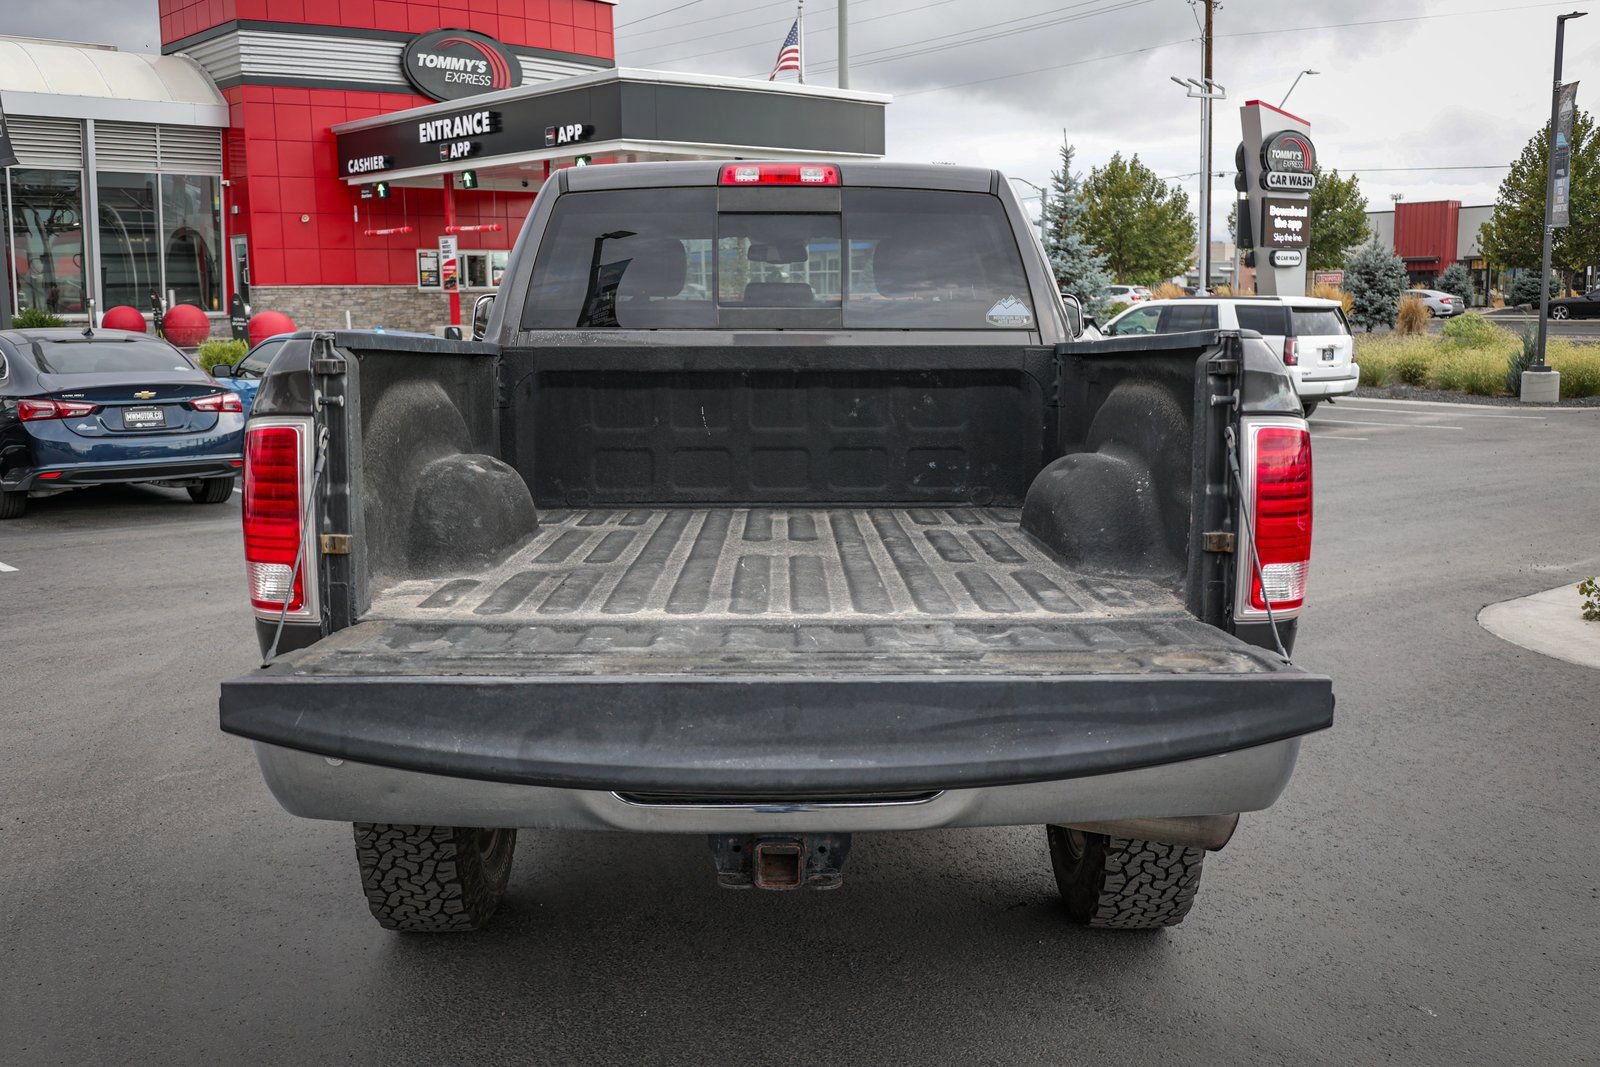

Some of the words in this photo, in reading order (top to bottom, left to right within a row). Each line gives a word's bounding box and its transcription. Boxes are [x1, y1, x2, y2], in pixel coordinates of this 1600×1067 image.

[417, 53, 487, 74] TOMMY'S
[445, 71, 492, 87] EXPRESS
[418, 111, 491, 143] ENTRANCE
[557, 123, 583, 144] APP
[450, 140, 471, 159] APP
[1271, 149, 1303, 161] TOMMY'S
[347, 155, 385, 173] CASHIER
[1282, 160, 1304, 169] EXPRESS
[1270, 174, 1287, 186] CAR
[1289, 175, 1313, 187] WASH
[1269, 205, 1308, 218] Download
[1274, 217, 1288, 229] the
[1288, 219, 1303, 232] app
[1273, 232, 1284, 244] Skip
[1284, 233, 1293, 243] the
